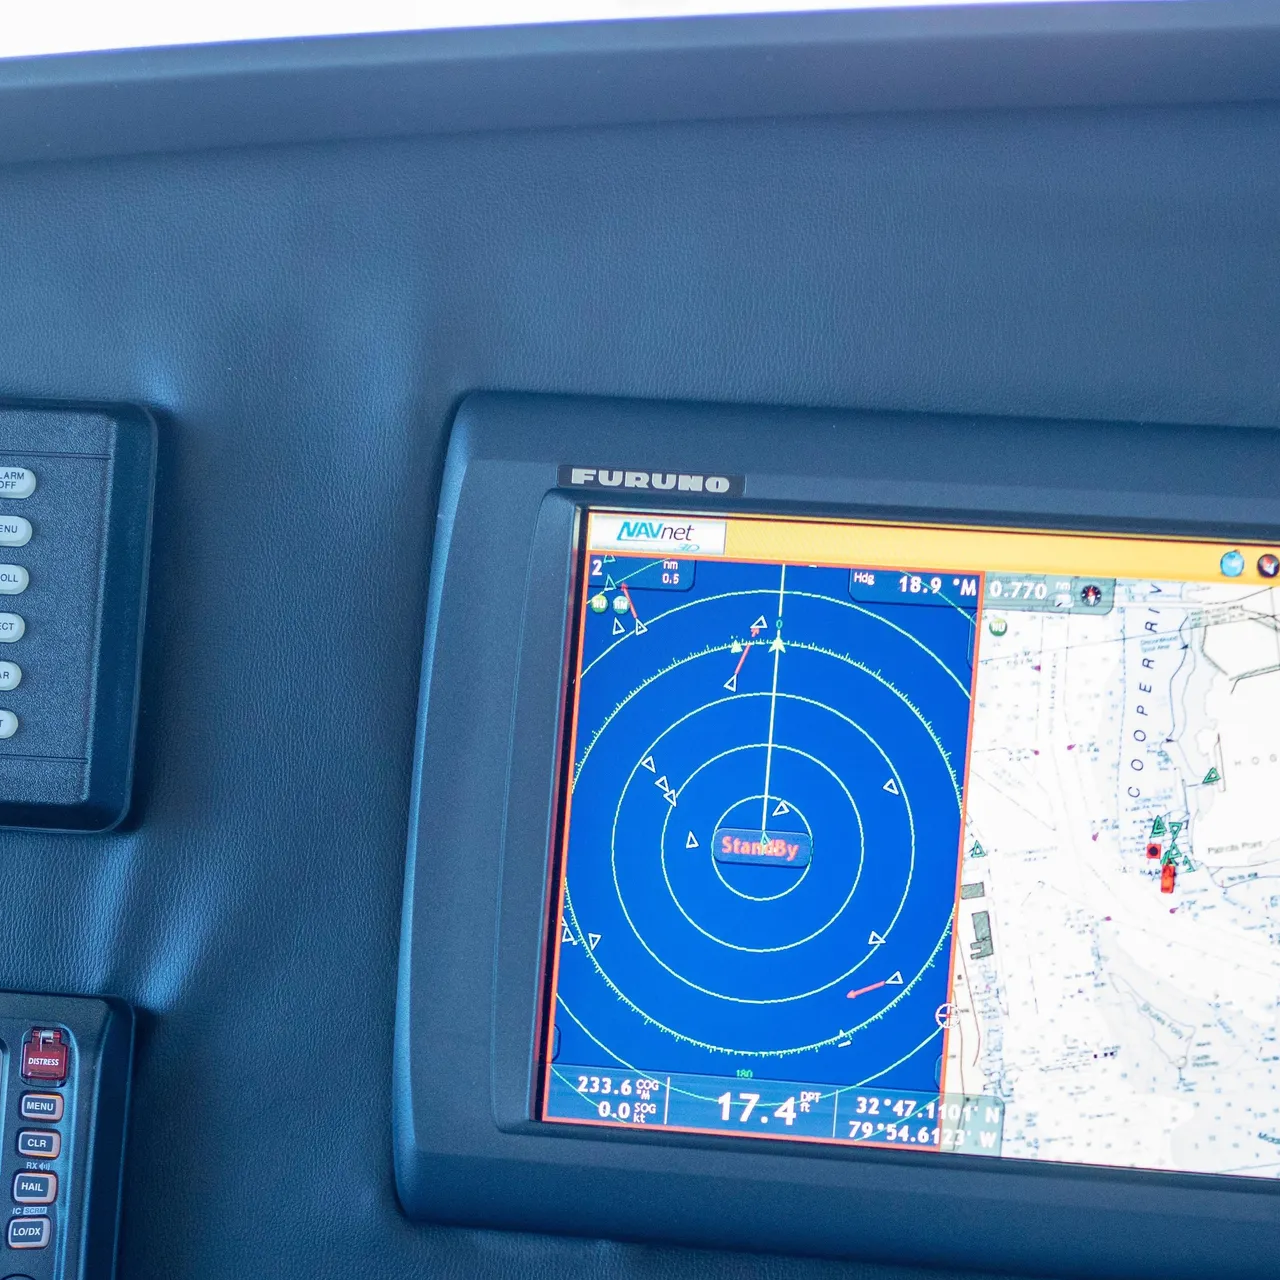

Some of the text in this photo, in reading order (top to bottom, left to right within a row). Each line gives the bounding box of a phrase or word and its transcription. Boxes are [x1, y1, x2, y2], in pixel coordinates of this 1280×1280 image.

[571, 467, 730, 494] FURUNO
[617, 520, 695, 542] NAVnet
[591, 559, 603, 576] 2
[662, 561, 679, 571] nm
[661, 572, 680, 585] 0.5
[853, 571, 875, 586] Hdg
[898, 575, 942, 595] 18.9
[989, 579, 1048, 600] 0.770
[721, 835, 800, 862] StandBy
[28, 1057, 60, 1066] DISTRESS
[577, 1075, 660, 1096] 233.6 COG
[26, 1101, 54, 1111] MENU
[597, 1101, 657, 1119] 0.0 SOG
[717, 1090, 822, 1126] 17.4 DPT
[799, 1102, 811, 1113] ft
[632, 1113, 646, 1124] kt
[984, 1106, 1000, 1124] N
[27, 1138, 47, 1148] CLR
[978, 1130, 998, 1149] W
[26, 1161, 38, 1170] RX
[21, 1182, 44, 1192] HAIL
[12, 1207, 22, 1215] IC
[13, 1227, 41, 1237] LO/DX
